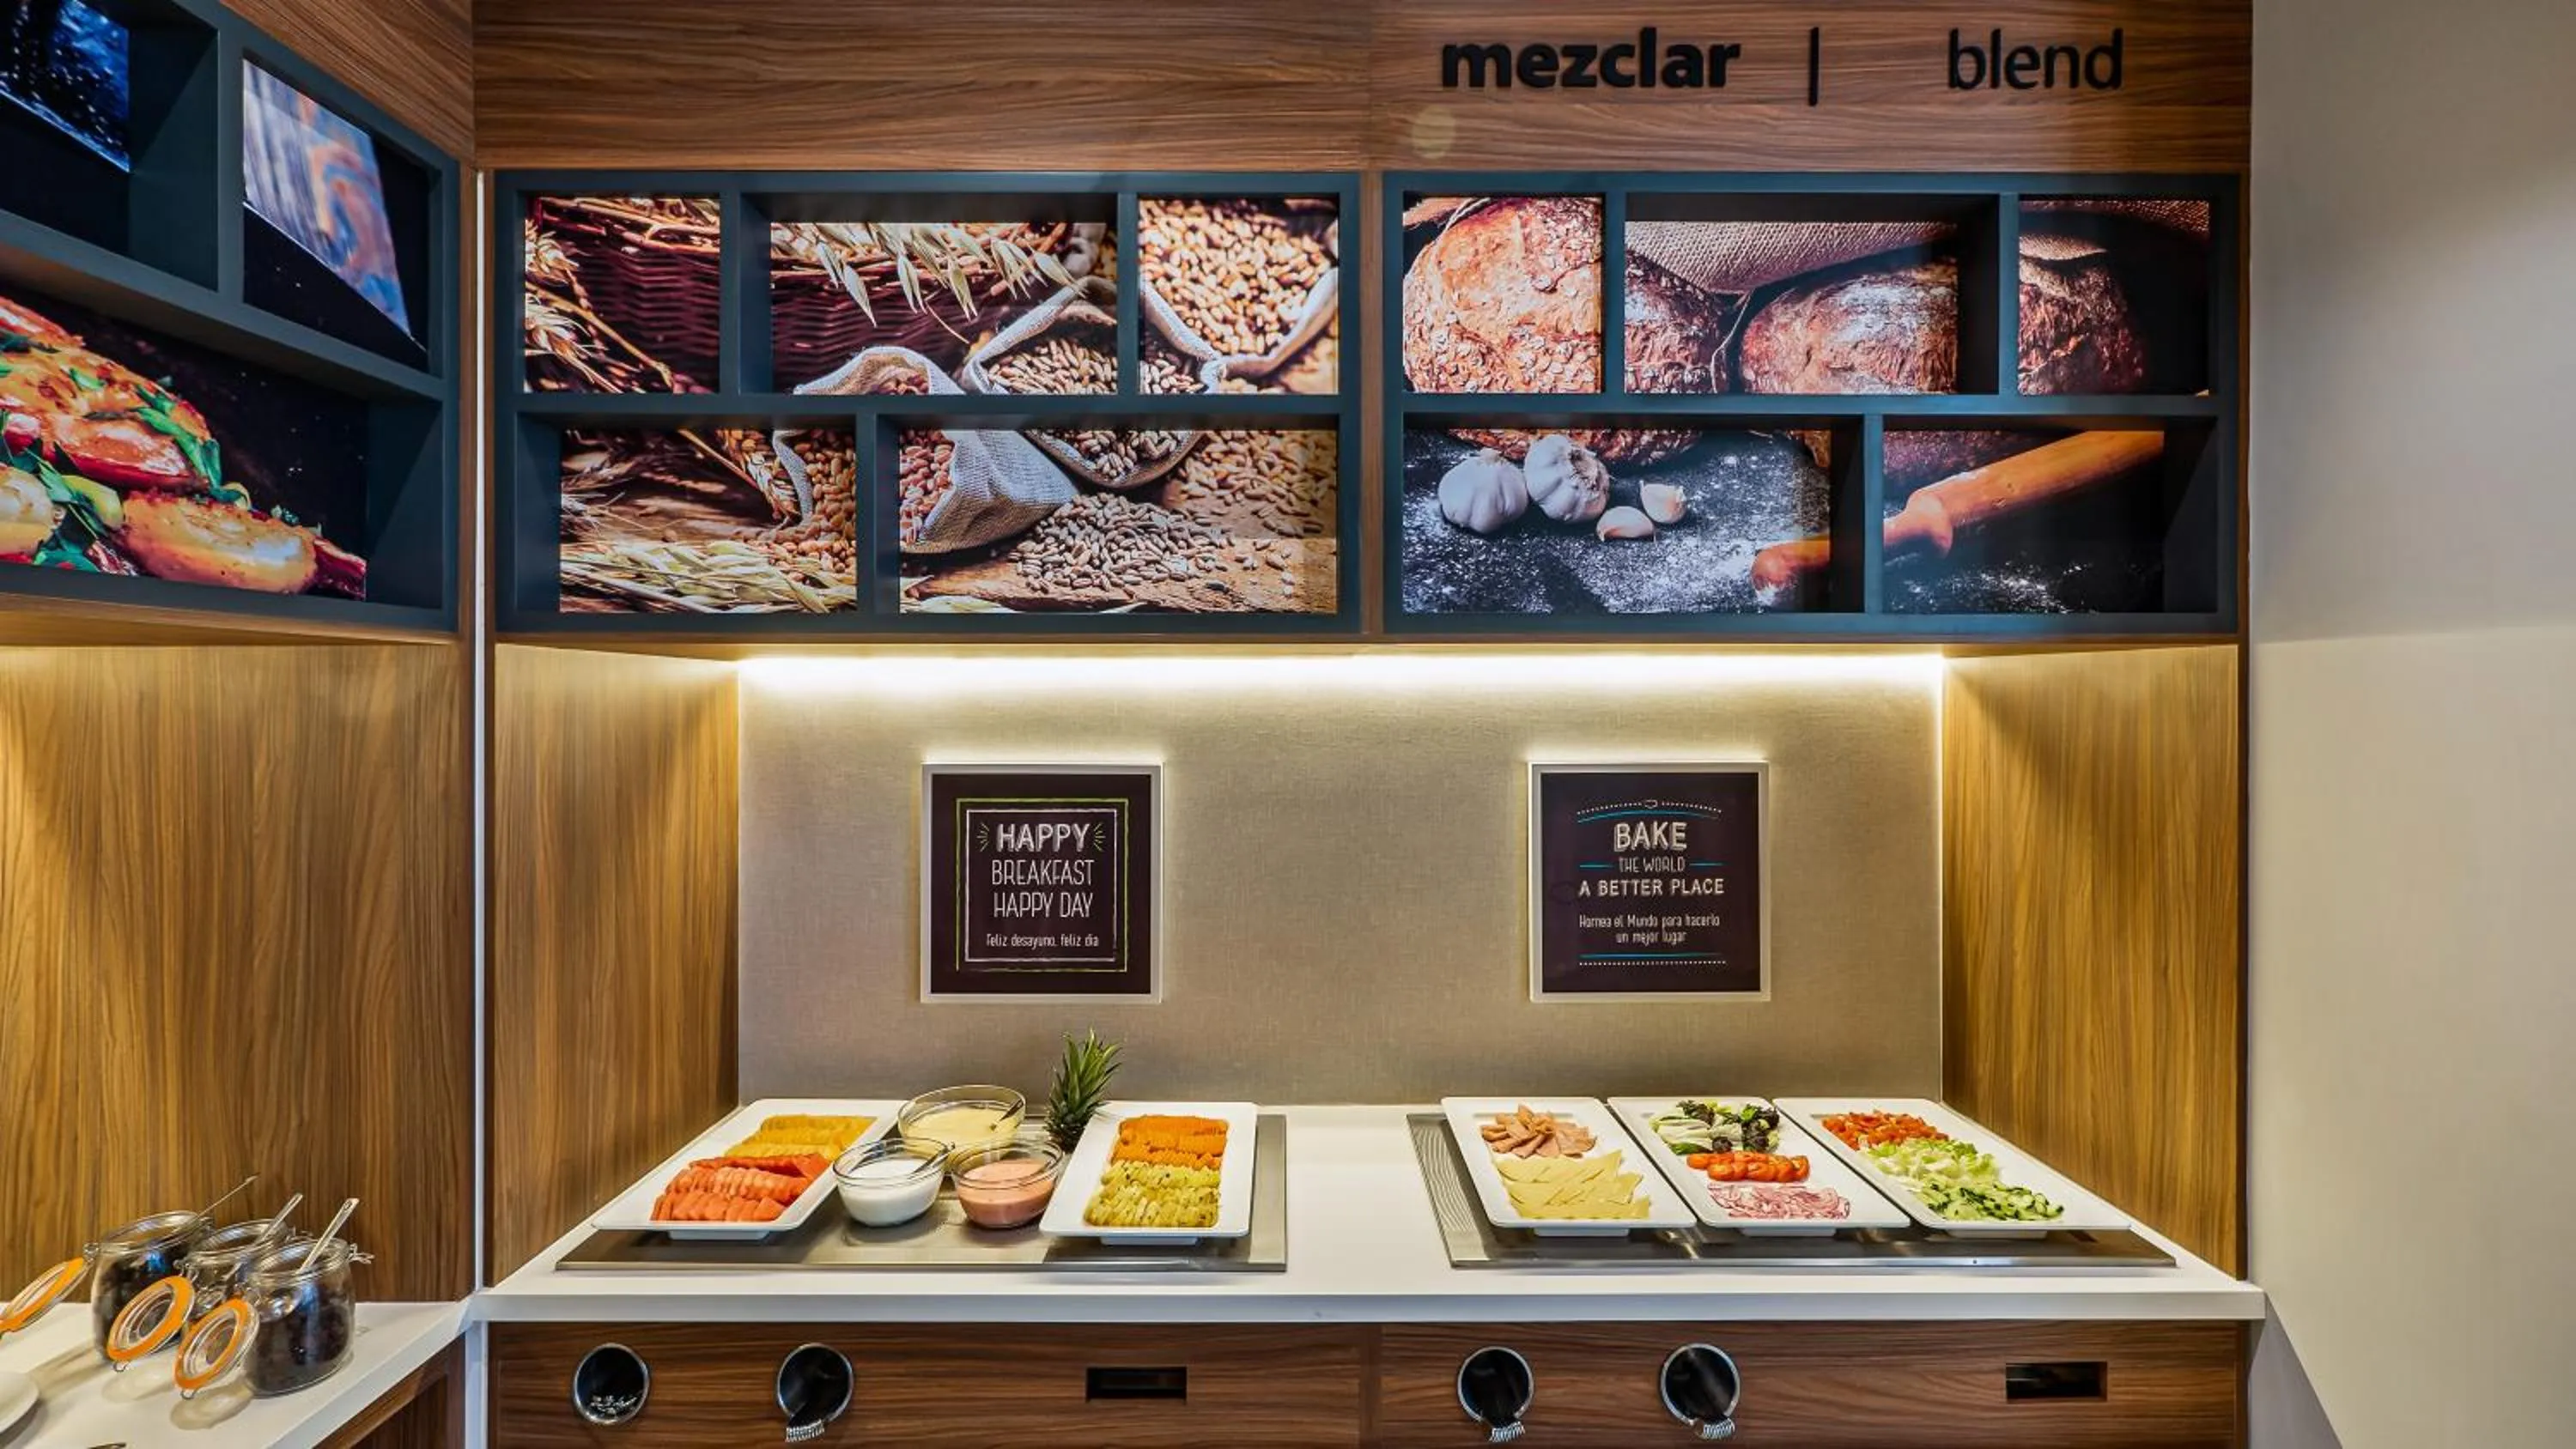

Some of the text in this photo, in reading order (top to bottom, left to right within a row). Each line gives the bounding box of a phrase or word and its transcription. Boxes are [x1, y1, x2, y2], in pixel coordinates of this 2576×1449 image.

[1442, 27, 2123, 90] mezclar blend
[996, 823, 1091, 852] HAPPY
[1613, 821, 1688, 852] BAKE
[992, 859, 1095, 886] BREAKFAST
[1619, 857, 1686, 873] THE WORLD
[1578, 878, 1725, 897] A BETTER PLACE
[993, 892, 1093, 918] HAPPY DAY
[1579, 913, 1721, 930] Hornea el Mundo para hacerlo
[987, 933, 1007, 946] Feliz
[1060, 933, 1081, 946] feliz
[1616, 930, 1687, 947] un mejor lugar
